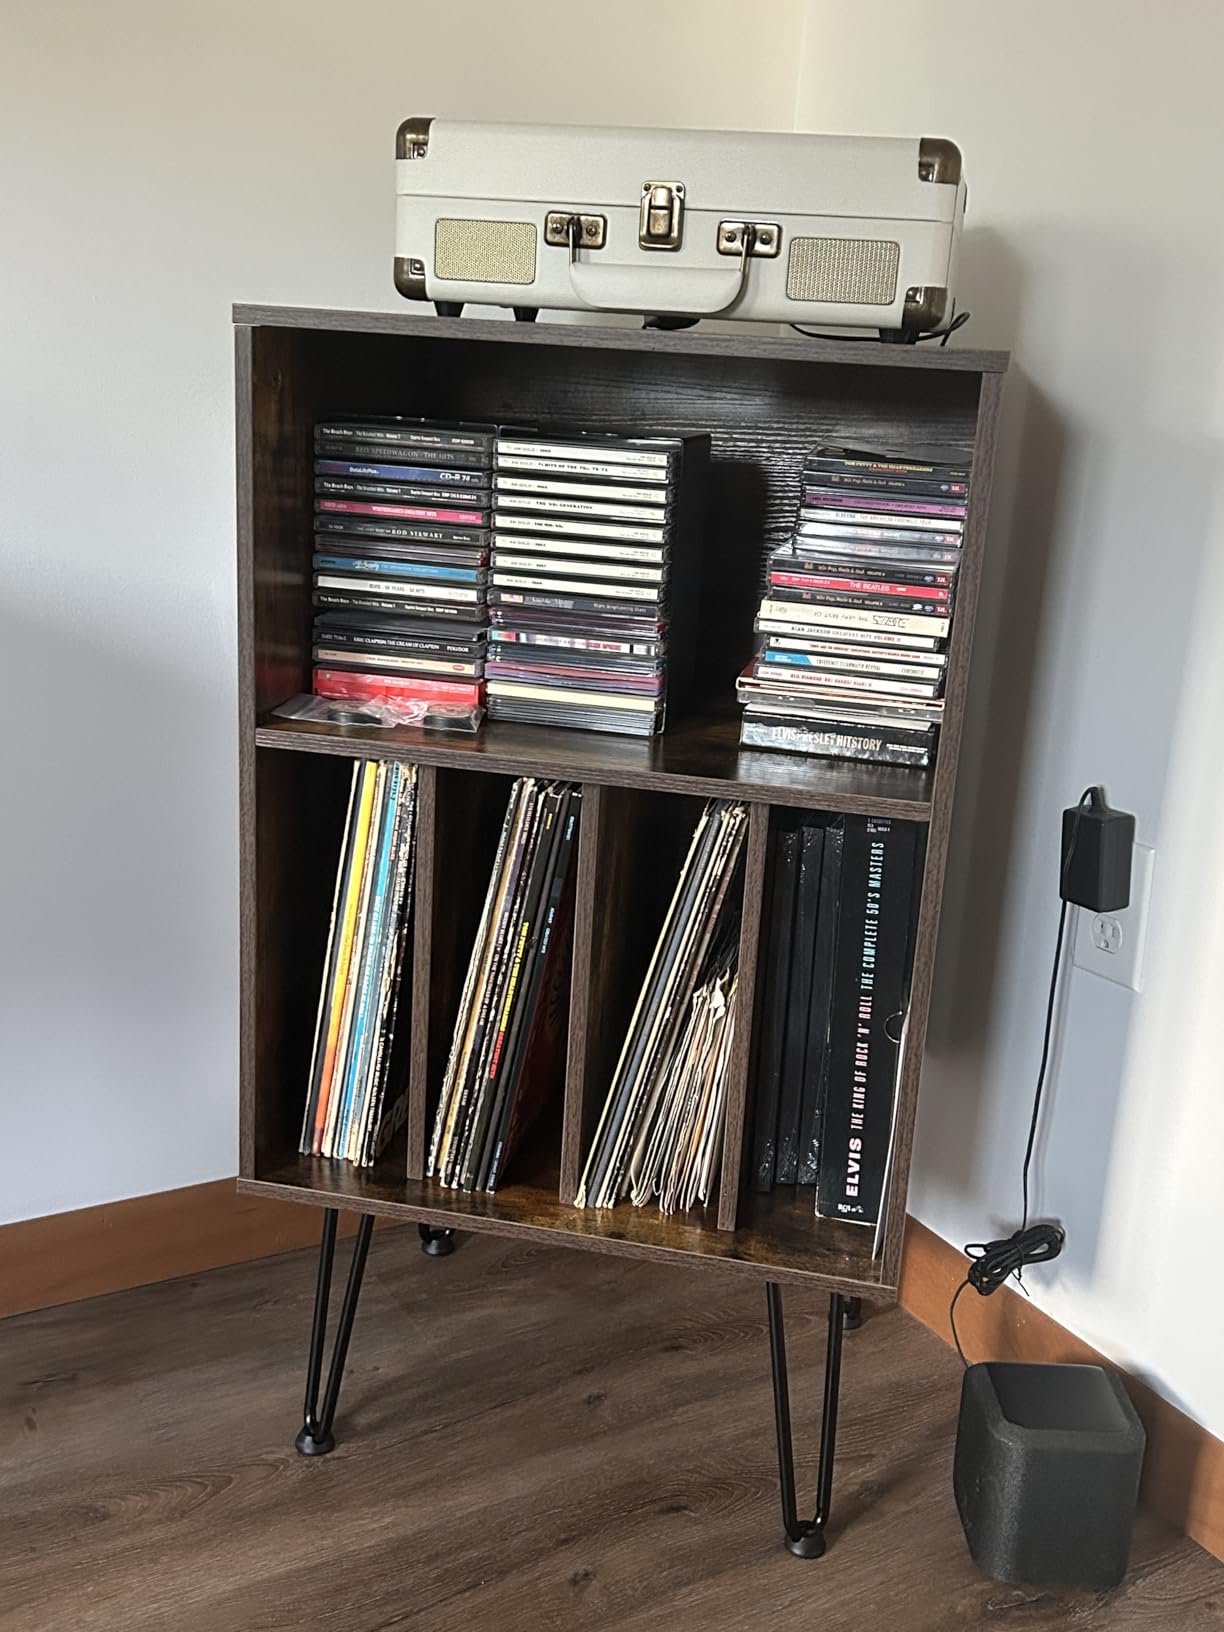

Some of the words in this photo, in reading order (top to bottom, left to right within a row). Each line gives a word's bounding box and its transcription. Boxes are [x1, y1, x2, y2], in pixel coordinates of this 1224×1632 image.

[372, 447, 419, 457] SPEEDWAGON
[440, 472, 460, 481] CD-R
[410, 530, 443, 539] STEWART
[863, 583, 890, 592] BEATLES
[772, 726, 797, 740] ELVIS
[837, 735, 882, 752] HITSTORY
[869, 842, 885, 888] MASTERS
[867, 892, 881, 915] 50'S
[862, 919, 879, 968] COMPLETE
[861, 972, 874, 990] THE
[859, 995, 873, 1019] ROLL
[856, 1042, 870, 1066] ROCK
[854, 1071, 867, 1082] OF
[852, 1087, 866, 1109] KING
[850, 1113, 864, 1129] THE
[845, 1137, 862, 1196] ELVIS
